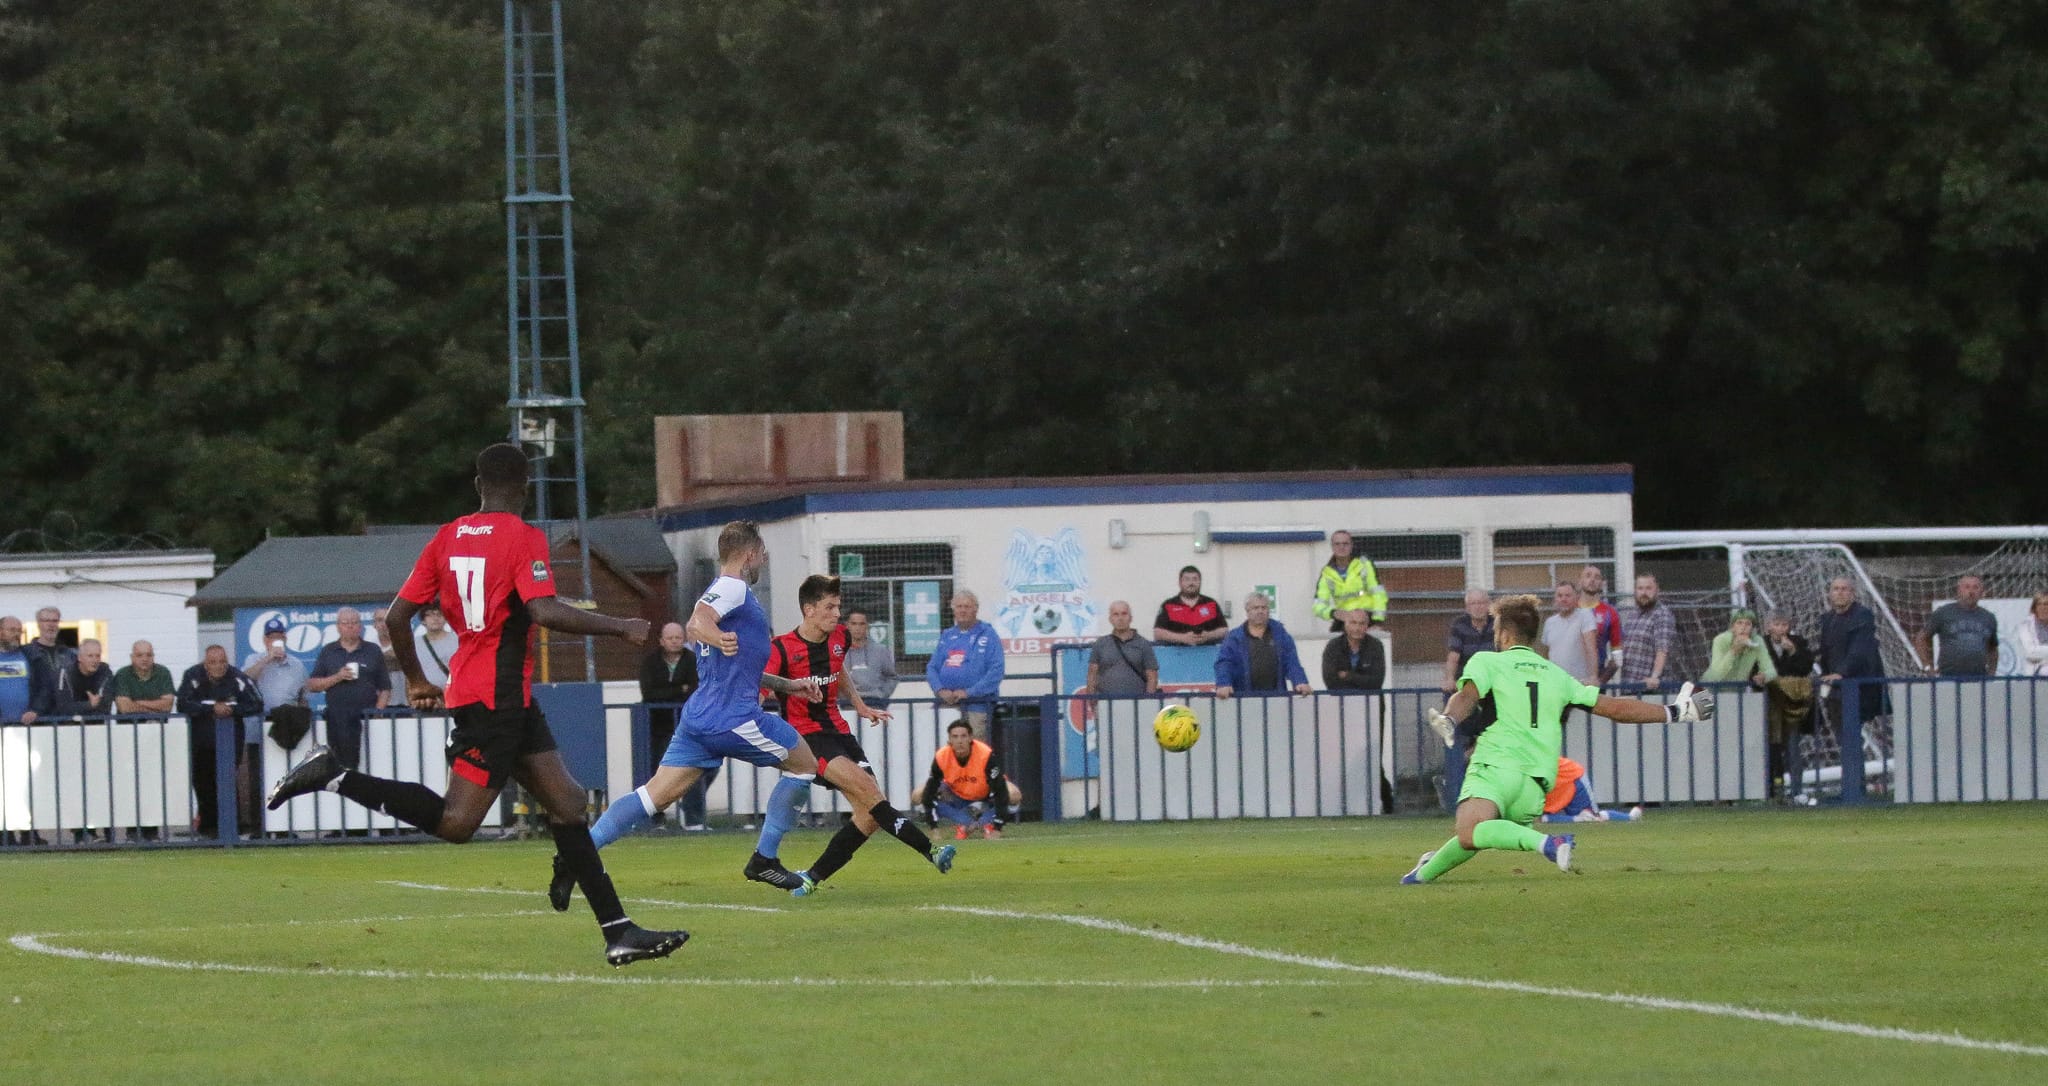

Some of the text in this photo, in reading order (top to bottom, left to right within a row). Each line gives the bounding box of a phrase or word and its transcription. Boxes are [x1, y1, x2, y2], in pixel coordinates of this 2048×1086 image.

[448, 556, 486, 632] 11
[1009, 592, 1084, 607] ANGELS
[289, 610, 340, 624] Kent an
[1525, 680, 1539, 729] 1
